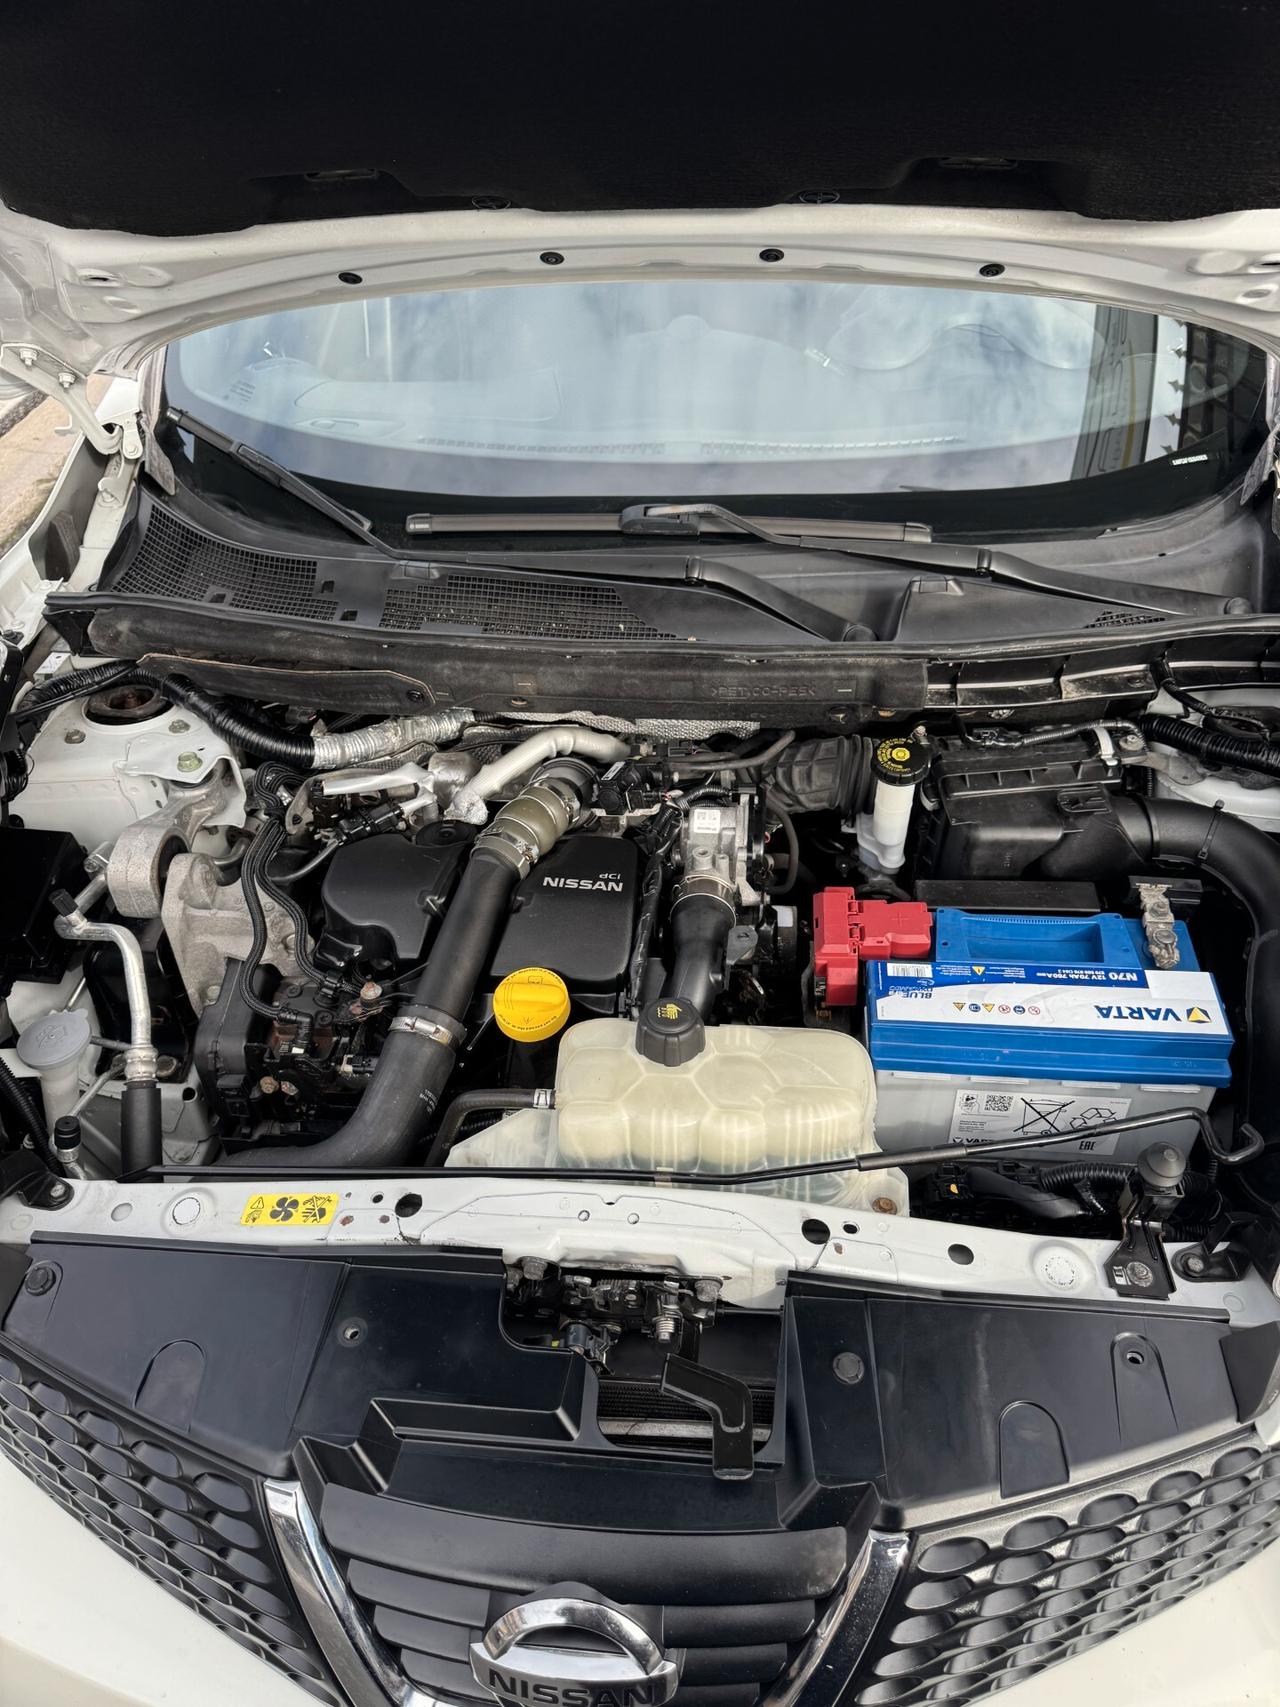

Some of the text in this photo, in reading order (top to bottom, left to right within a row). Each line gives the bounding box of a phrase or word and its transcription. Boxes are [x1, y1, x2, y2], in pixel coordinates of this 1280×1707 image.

[542, 876, 624, 893] NISSAN
[1108, 971, 1138, 982] N70
[901, 991, 932, 999] BLUE
[1093, 1004, 1182, 1022] VARTA
[489, 1667, 653, 1707] NISSAN
